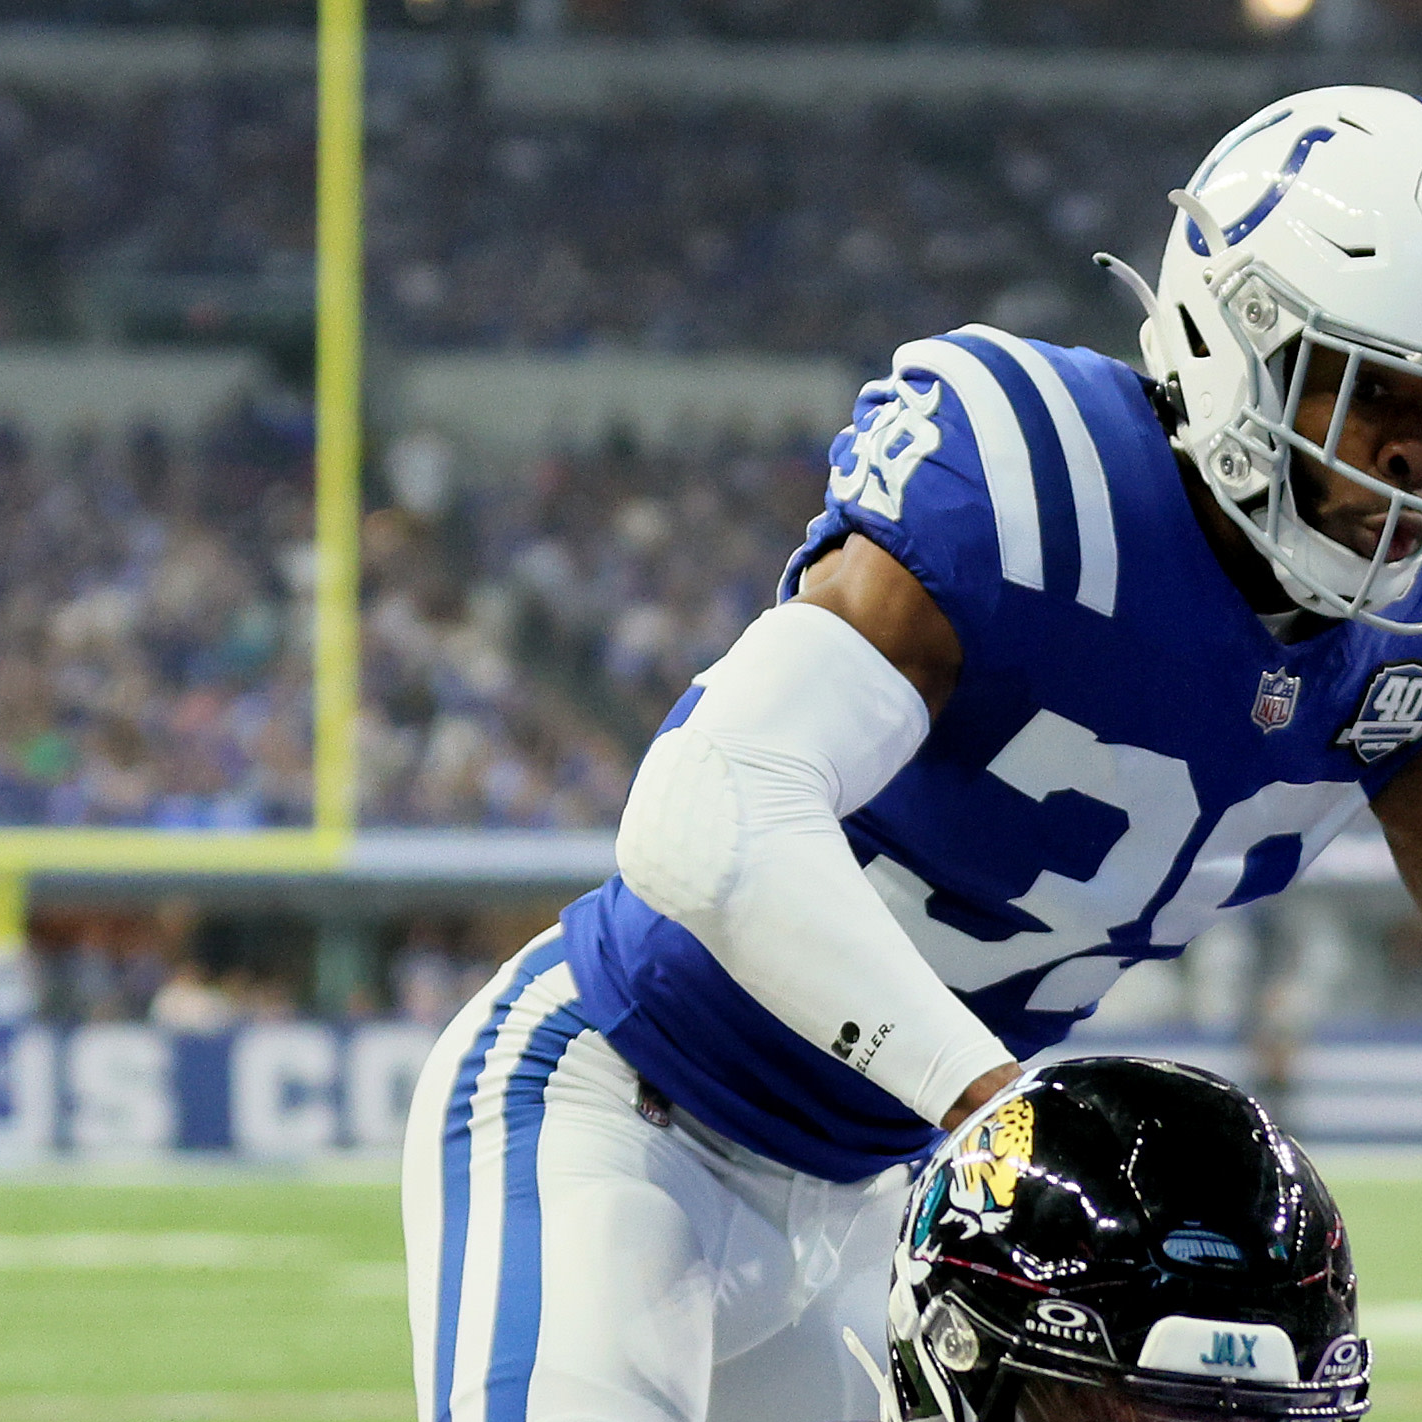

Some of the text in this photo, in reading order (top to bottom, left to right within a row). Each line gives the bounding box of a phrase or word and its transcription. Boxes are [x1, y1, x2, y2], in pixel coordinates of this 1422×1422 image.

[1257, 697, 1288, 723] NFL
[864, 708, 1372, 1012] 39
[1024, 1318, 1098, 1344] OAKLEY
[1200, 1331, 1258, 1368] JAX
